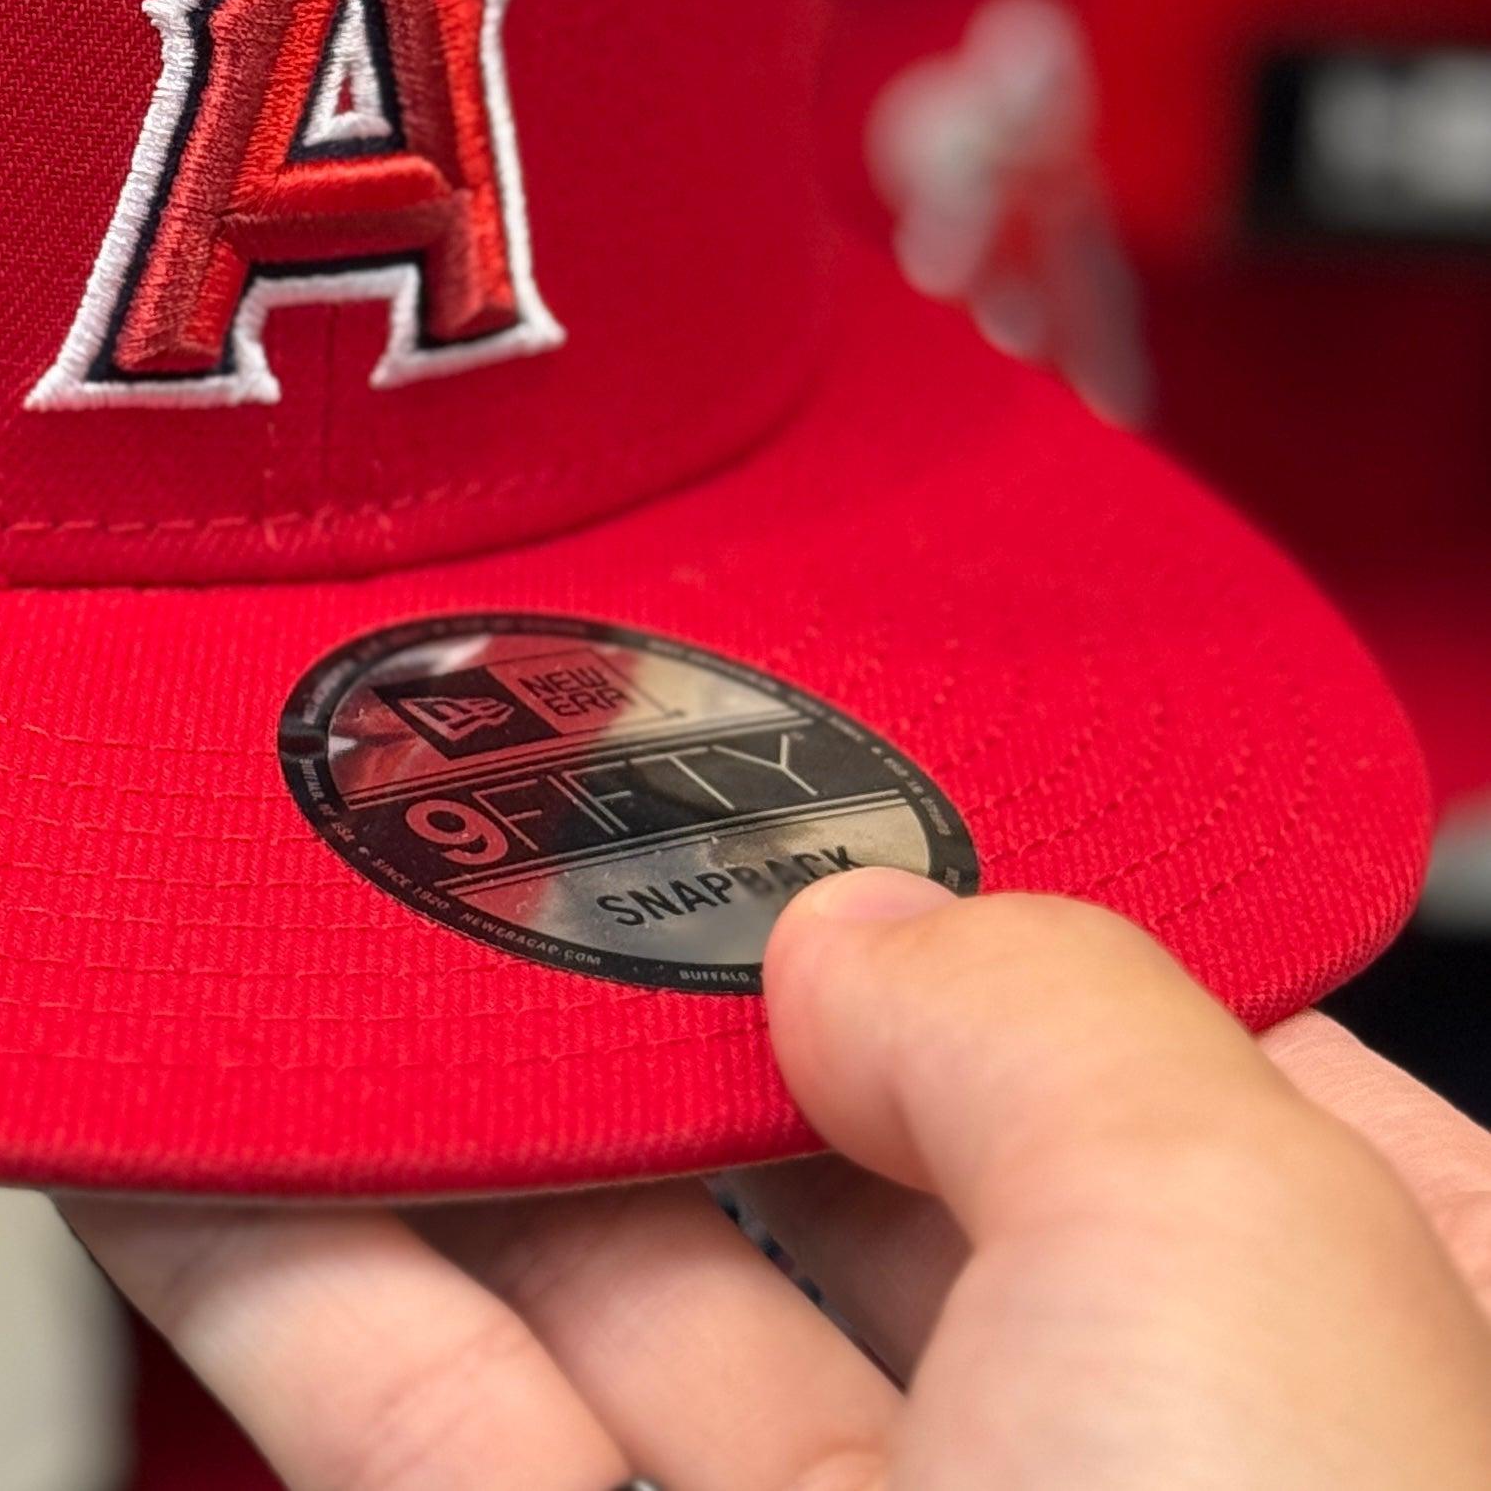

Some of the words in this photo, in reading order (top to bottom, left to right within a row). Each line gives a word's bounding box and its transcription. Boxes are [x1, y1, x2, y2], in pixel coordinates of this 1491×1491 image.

[518, 666, 609, 699] NEW
[543, 686, 637, 717] ERA
[405, 732, 819, 867] 9FIFTY
